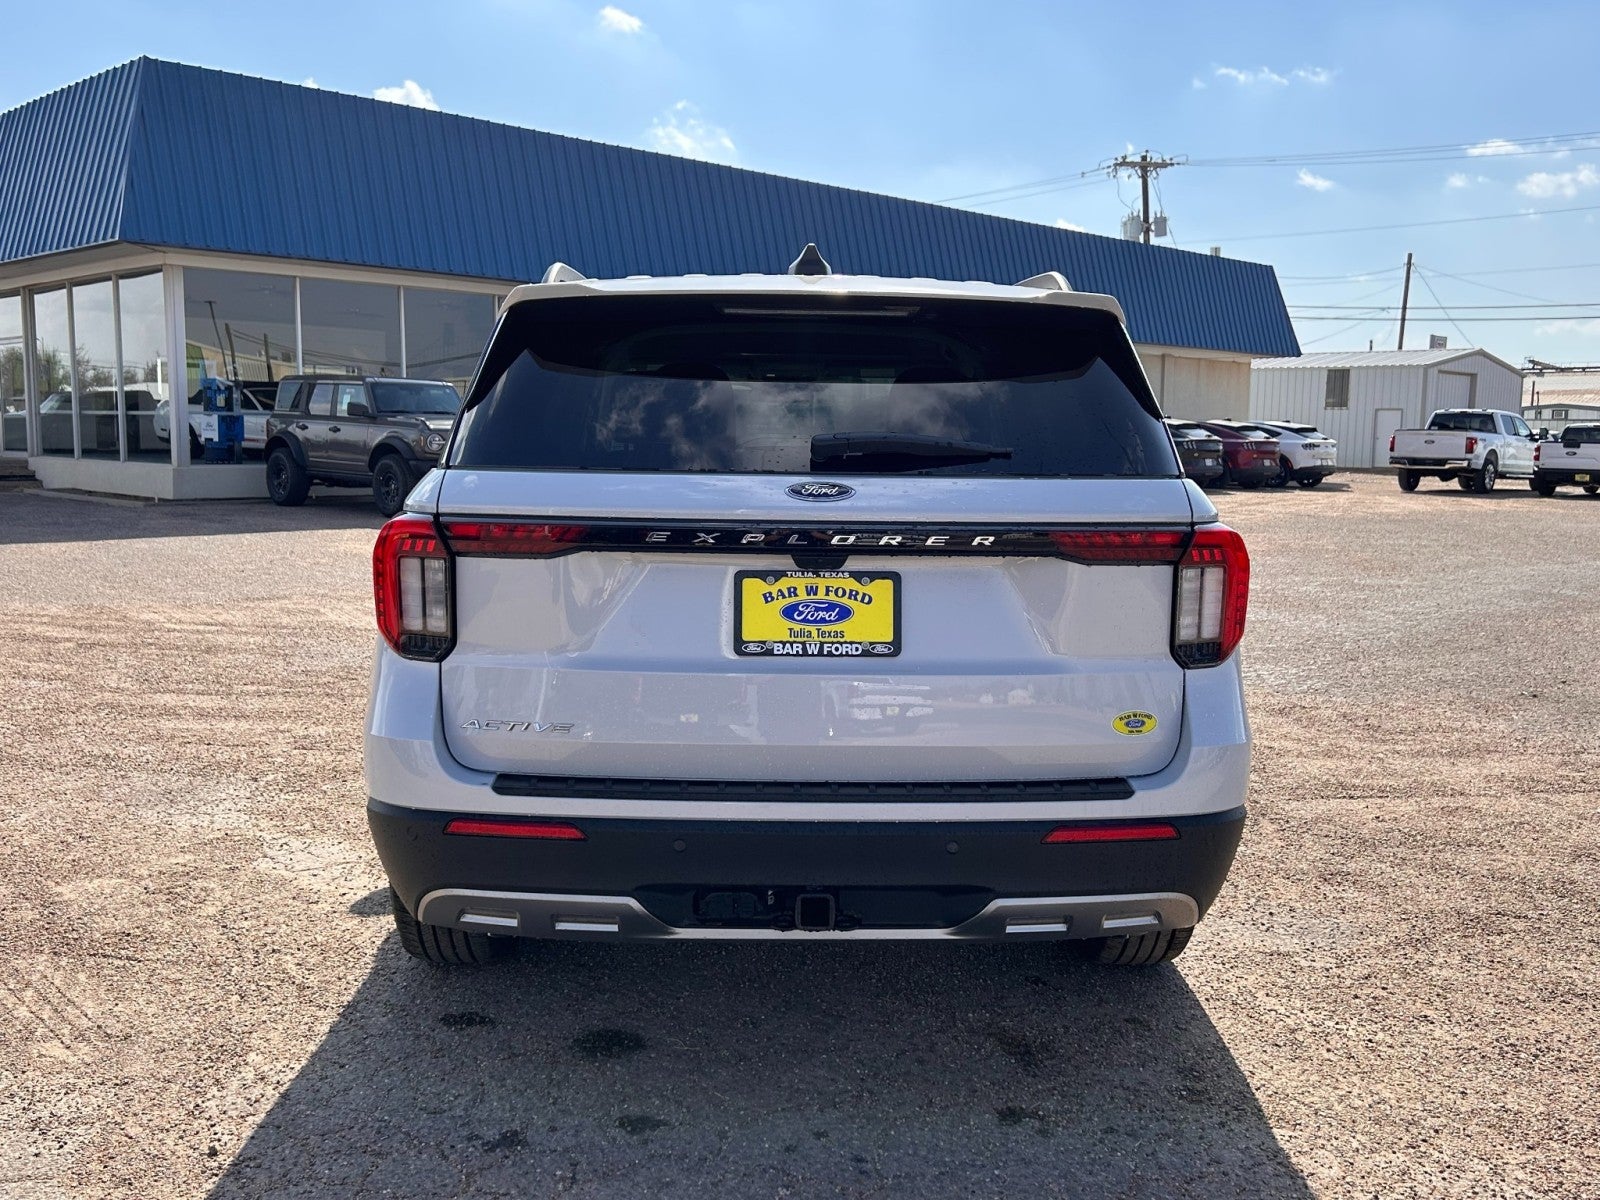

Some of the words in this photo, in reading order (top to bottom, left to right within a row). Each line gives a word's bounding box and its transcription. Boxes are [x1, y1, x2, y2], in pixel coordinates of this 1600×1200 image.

[802, 484, 839, 495] Ford
[645, 531, 996, 546] EXPLORER
[786, 571, 816, 579] TULIA,
[819, 571, 850, 579] TEXAS
[762, 586, 798, 604] BAR
[805, 583, 819, 597] W
[824, 585, 873, 605] FORD
[793, 602, 839, 621] Ford
[787, 627, 815, 640] Tulia,
[816, 627, 845, 639] Texas
[773, 643, 802, 655] BAR
[805, 642, 820, 655] W
[823, 643, 863, 655] FORD
[461, 719, 575, 733] ACTIVE
